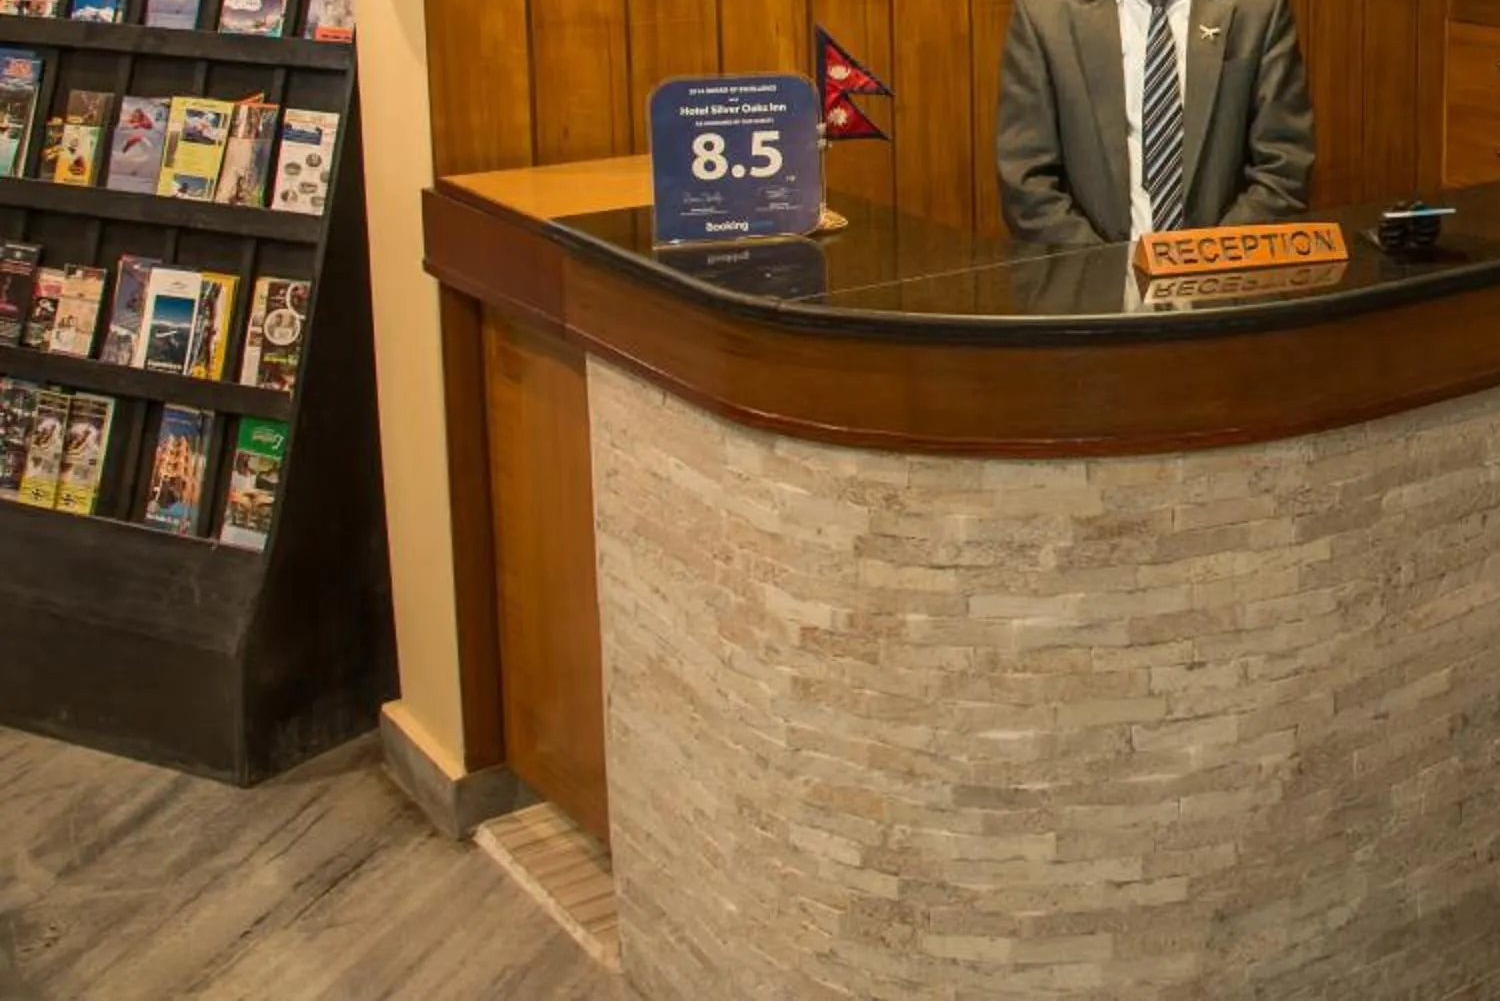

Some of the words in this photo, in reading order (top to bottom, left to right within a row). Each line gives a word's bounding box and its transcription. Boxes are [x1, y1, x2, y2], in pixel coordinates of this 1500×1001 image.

[679, 106, 709, 116] Hotel
[711, 104, 740, 115] Silver
[741, 104, 768, 114] Oaks
[769, 103, 787, 112] Inn
[691, 130, 783, 180] 8.5
[705, 221, 749, 232] Booking
[1152, 230, 1337, 266] RECEPTION
